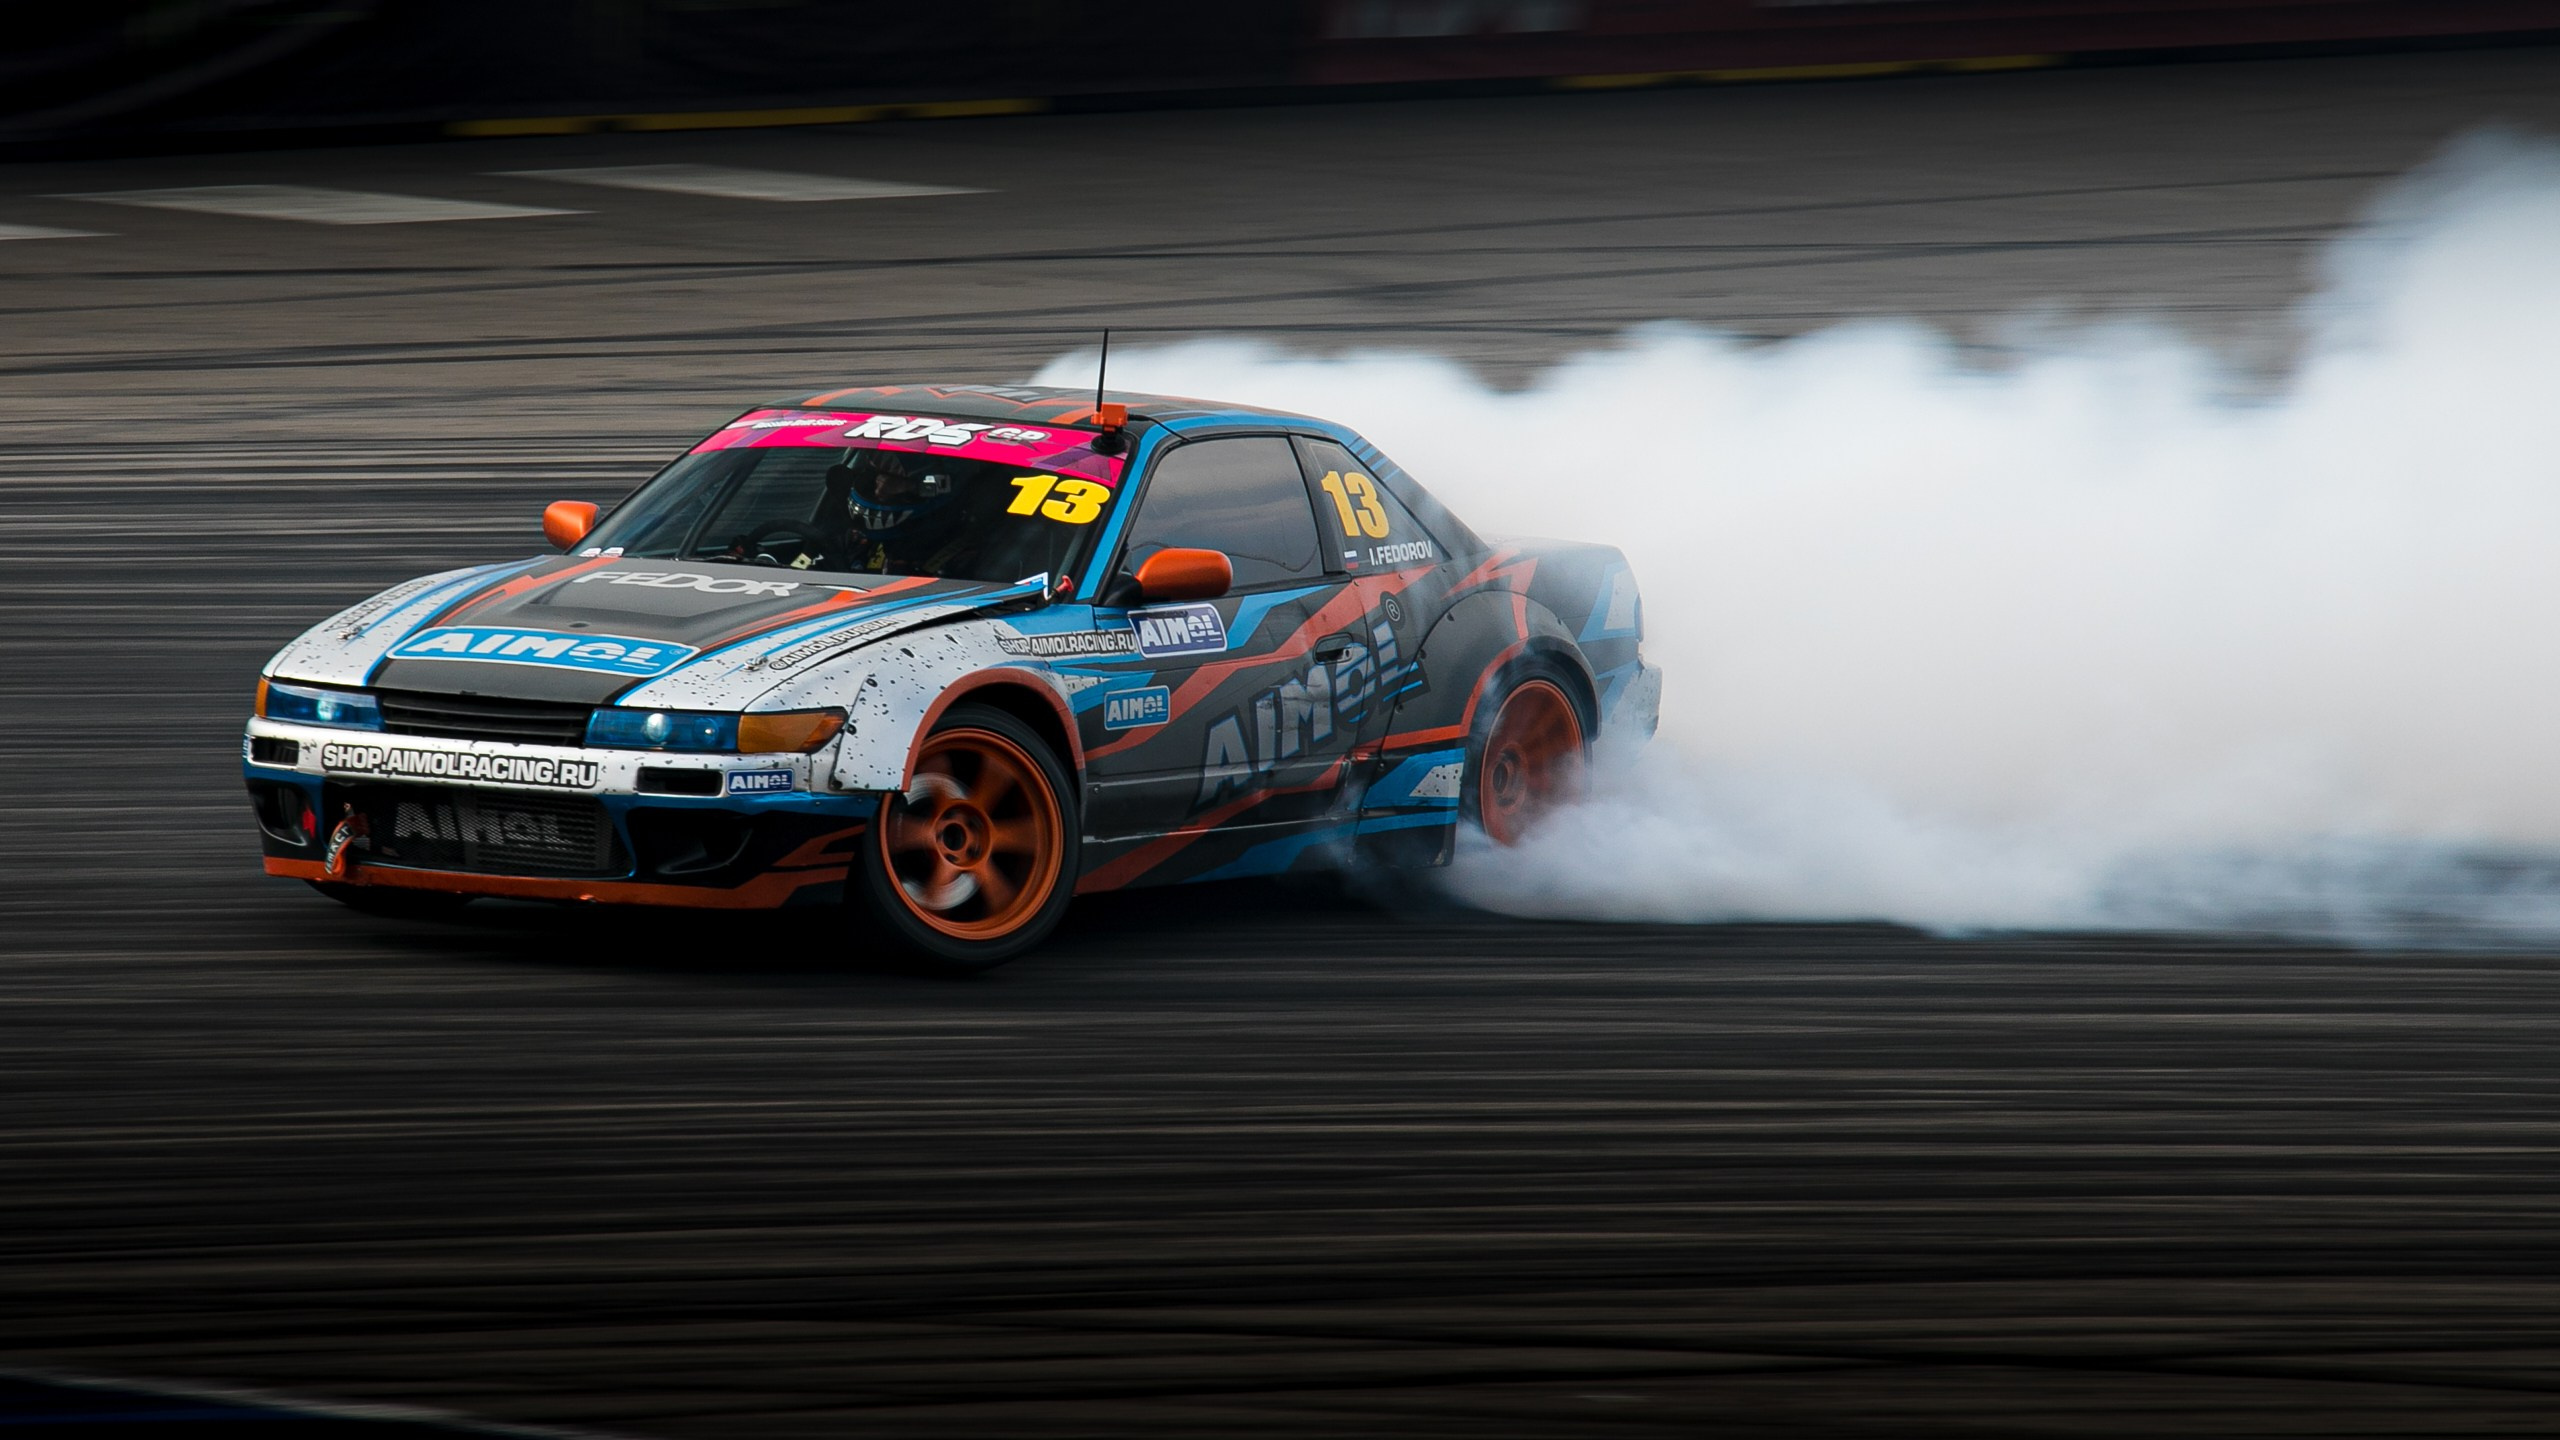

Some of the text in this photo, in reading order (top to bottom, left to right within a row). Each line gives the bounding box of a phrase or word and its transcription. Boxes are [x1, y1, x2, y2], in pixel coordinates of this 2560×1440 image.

[844, 416, 996, 446] RDS
[1006, 474, 1111, 524] 13
[1321, 470, 1390, 539] 13
[1369, 540, 1433, 566] I.FEDOROV
[572, 571, 800, 597] FEDOR
[1139, 614, 1222, 648] AIMOL
[410, 632, 661, 669] AIMOL
[1106, 694, 1168, 722] AIMOL
[1196, 620, 1424, 806] AIMOL
[322, 745, 598, 787] SHOP.AIMOLRACING.RU
[730, 774, 791, 790] AIMOL
[393, 801, 577, 850] AIMOL
